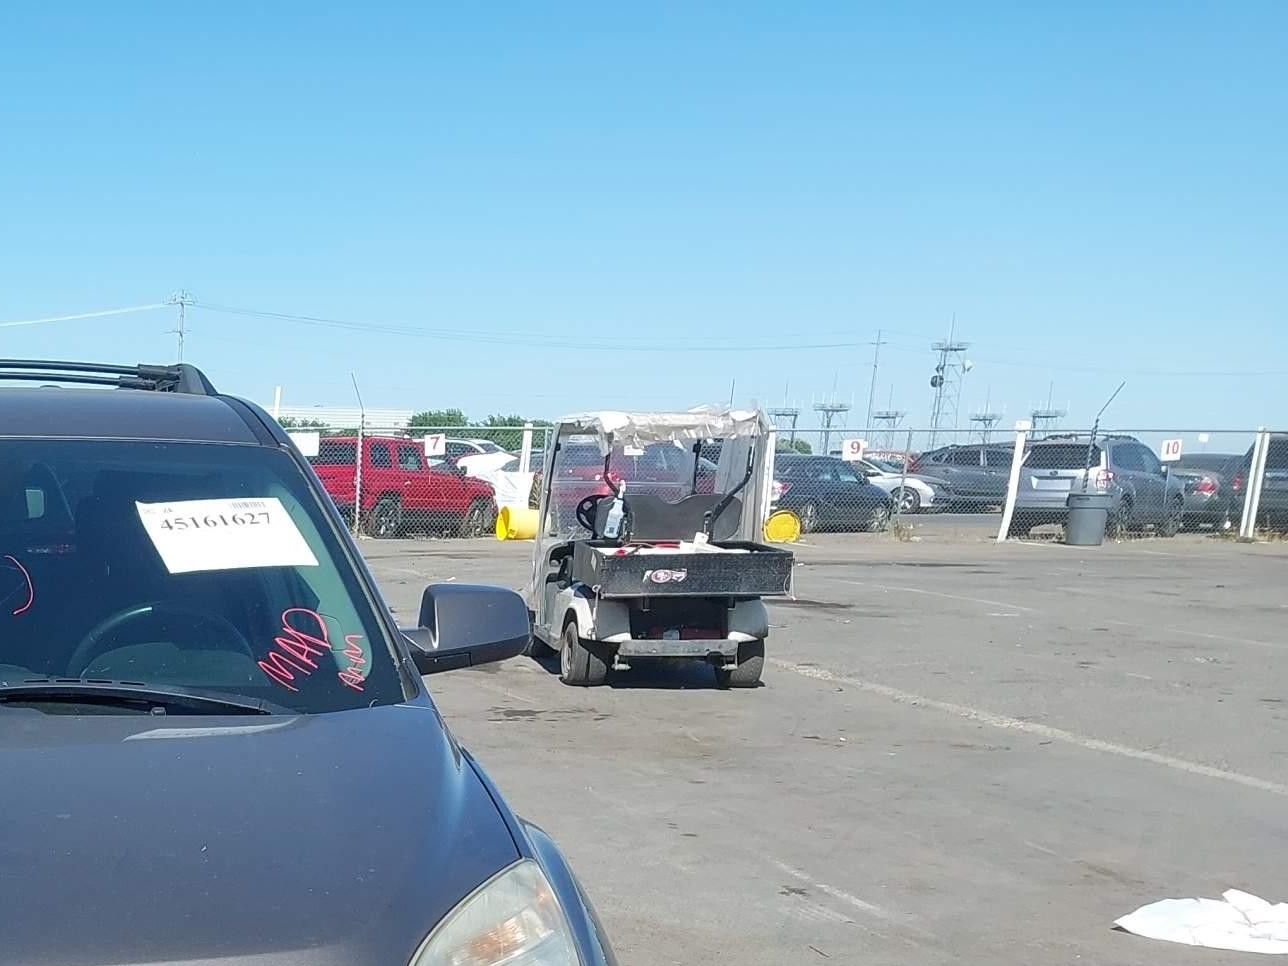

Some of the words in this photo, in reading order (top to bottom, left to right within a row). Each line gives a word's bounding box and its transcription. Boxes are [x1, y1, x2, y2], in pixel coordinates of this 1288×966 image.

[430, 436, 441, 450] 7
[850, 441, 861, 455] 9
[1165, 441, 1179, 456] 10
[160, 512, 271, 531] 45161627
